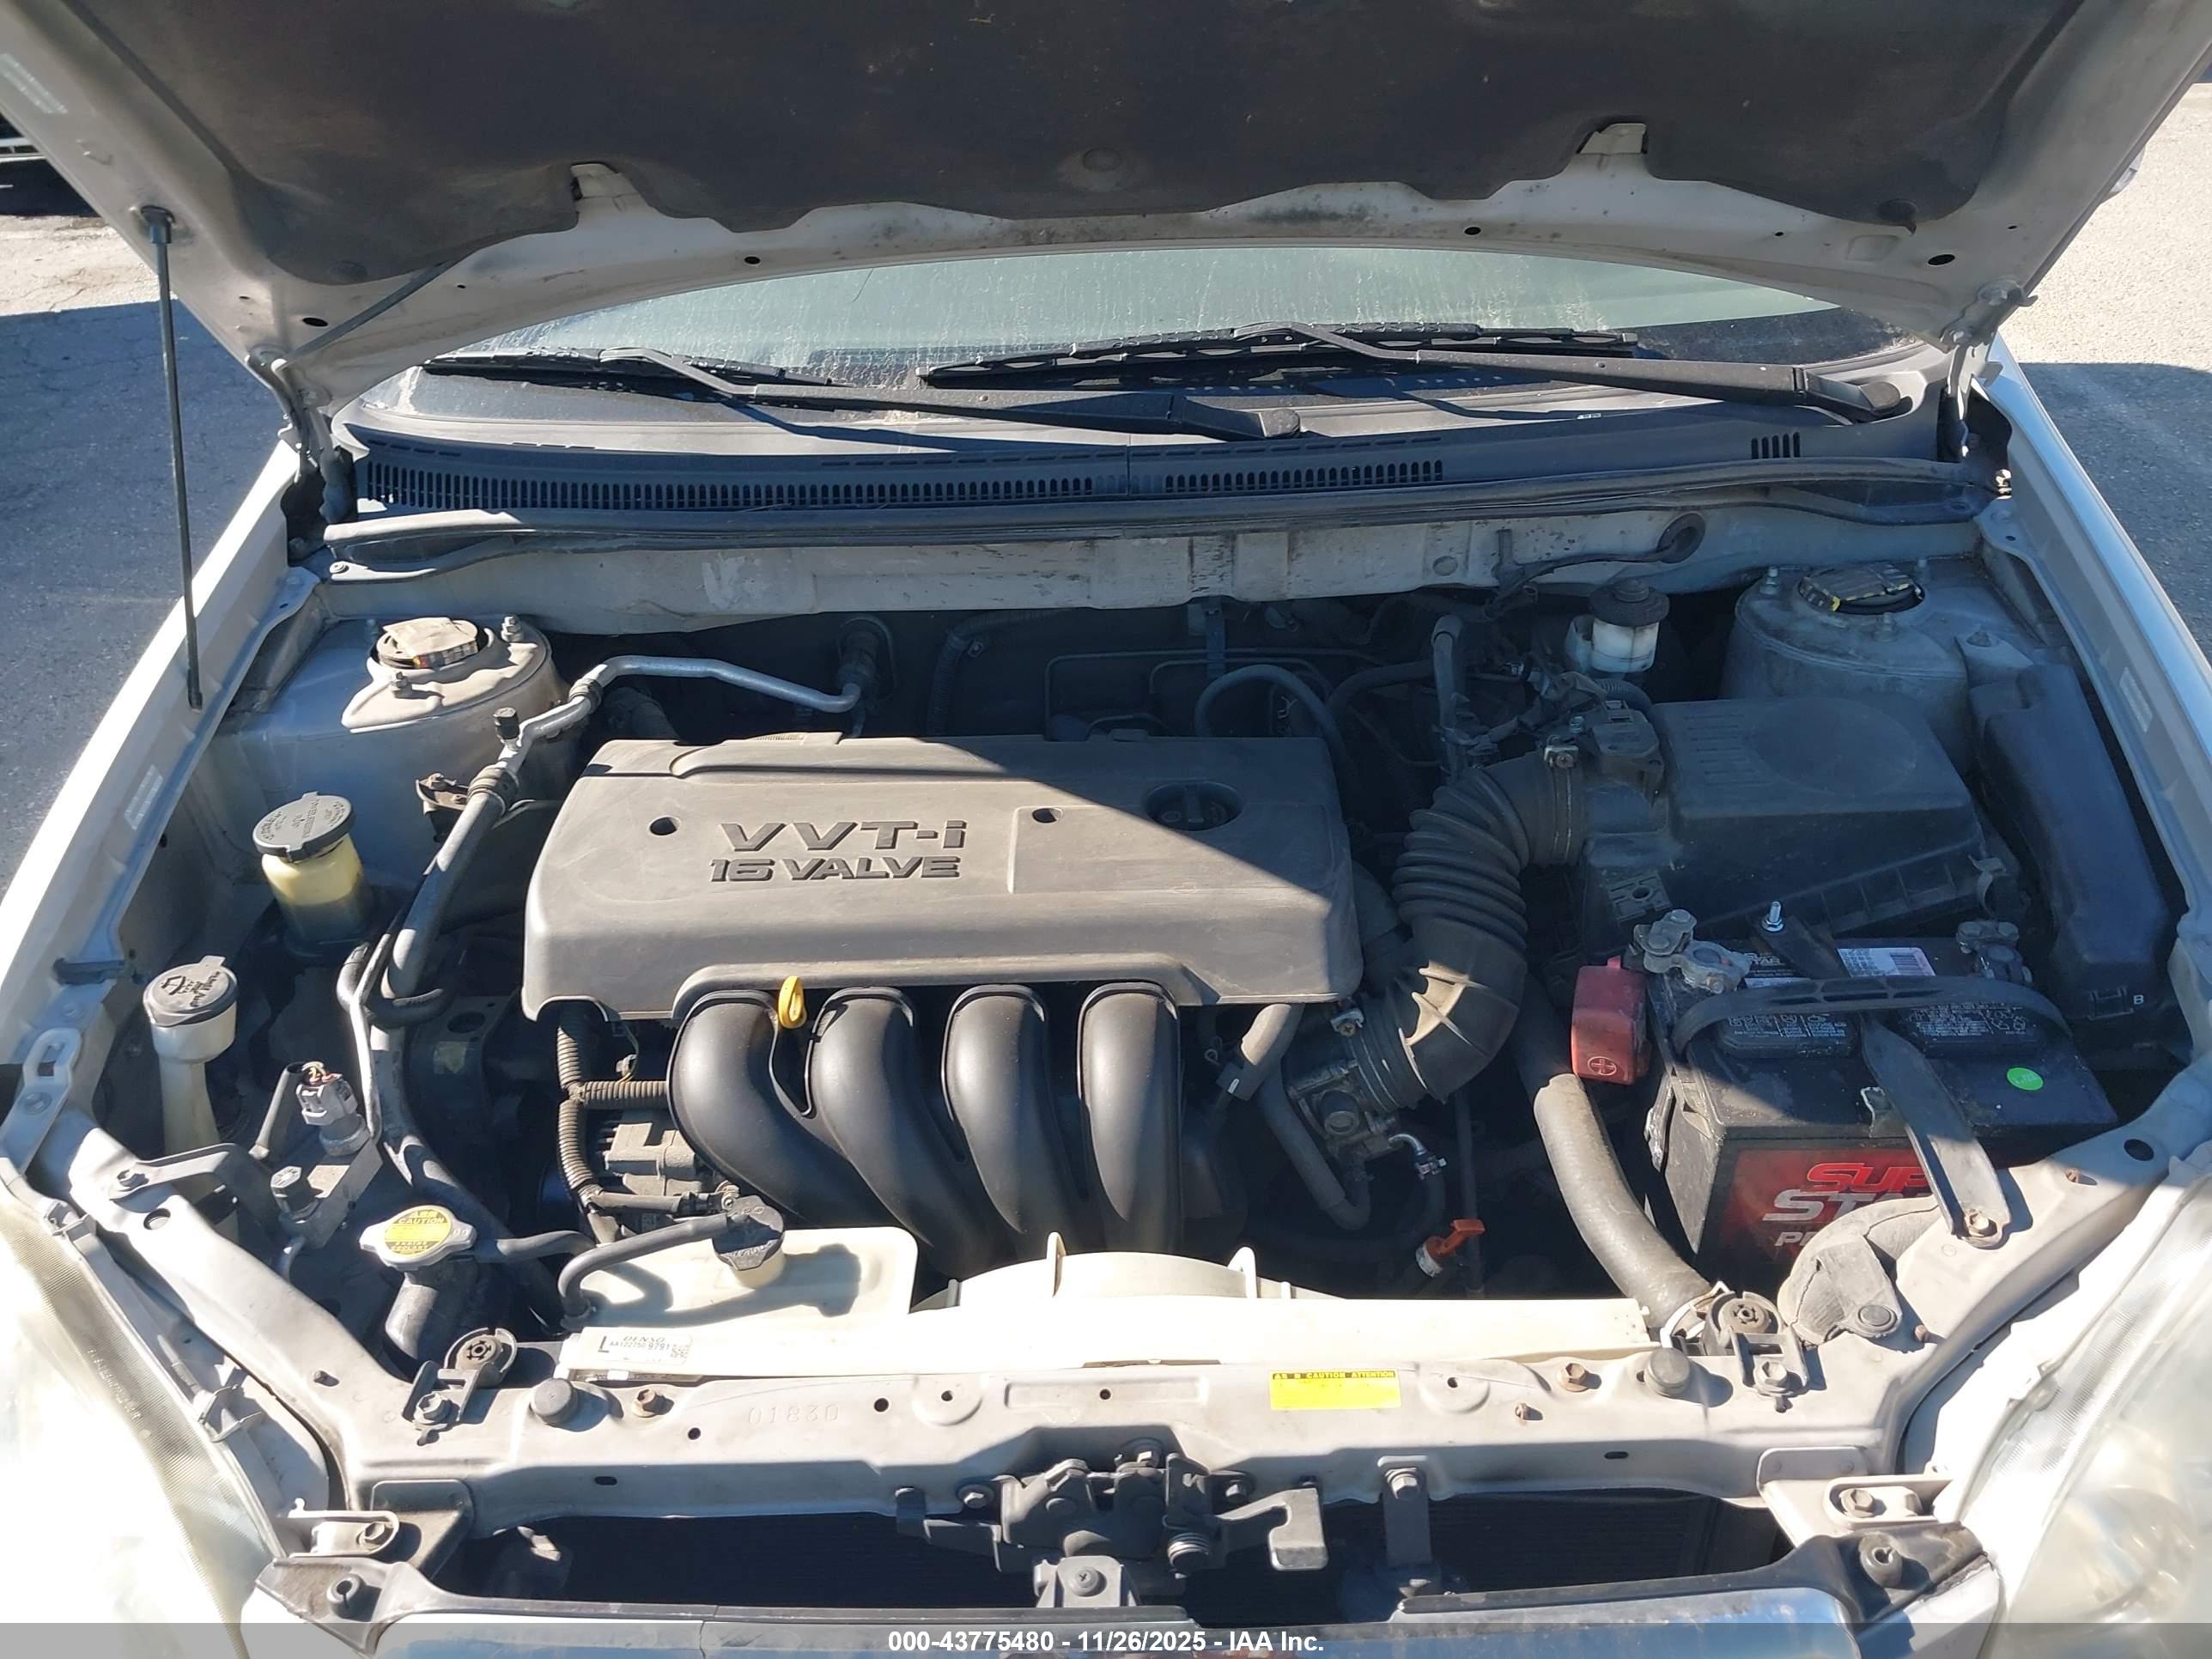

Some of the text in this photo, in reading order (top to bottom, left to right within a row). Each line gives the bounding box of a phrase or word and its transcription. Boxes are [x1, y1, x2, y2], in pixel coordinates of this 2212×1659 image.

[720, 819, 967, 852] VVT-i
[709, 856, 962, 882] 16 VALVE
[2133, 994, 2144, 1005] B
[598, 1335, 611, 1353] L
